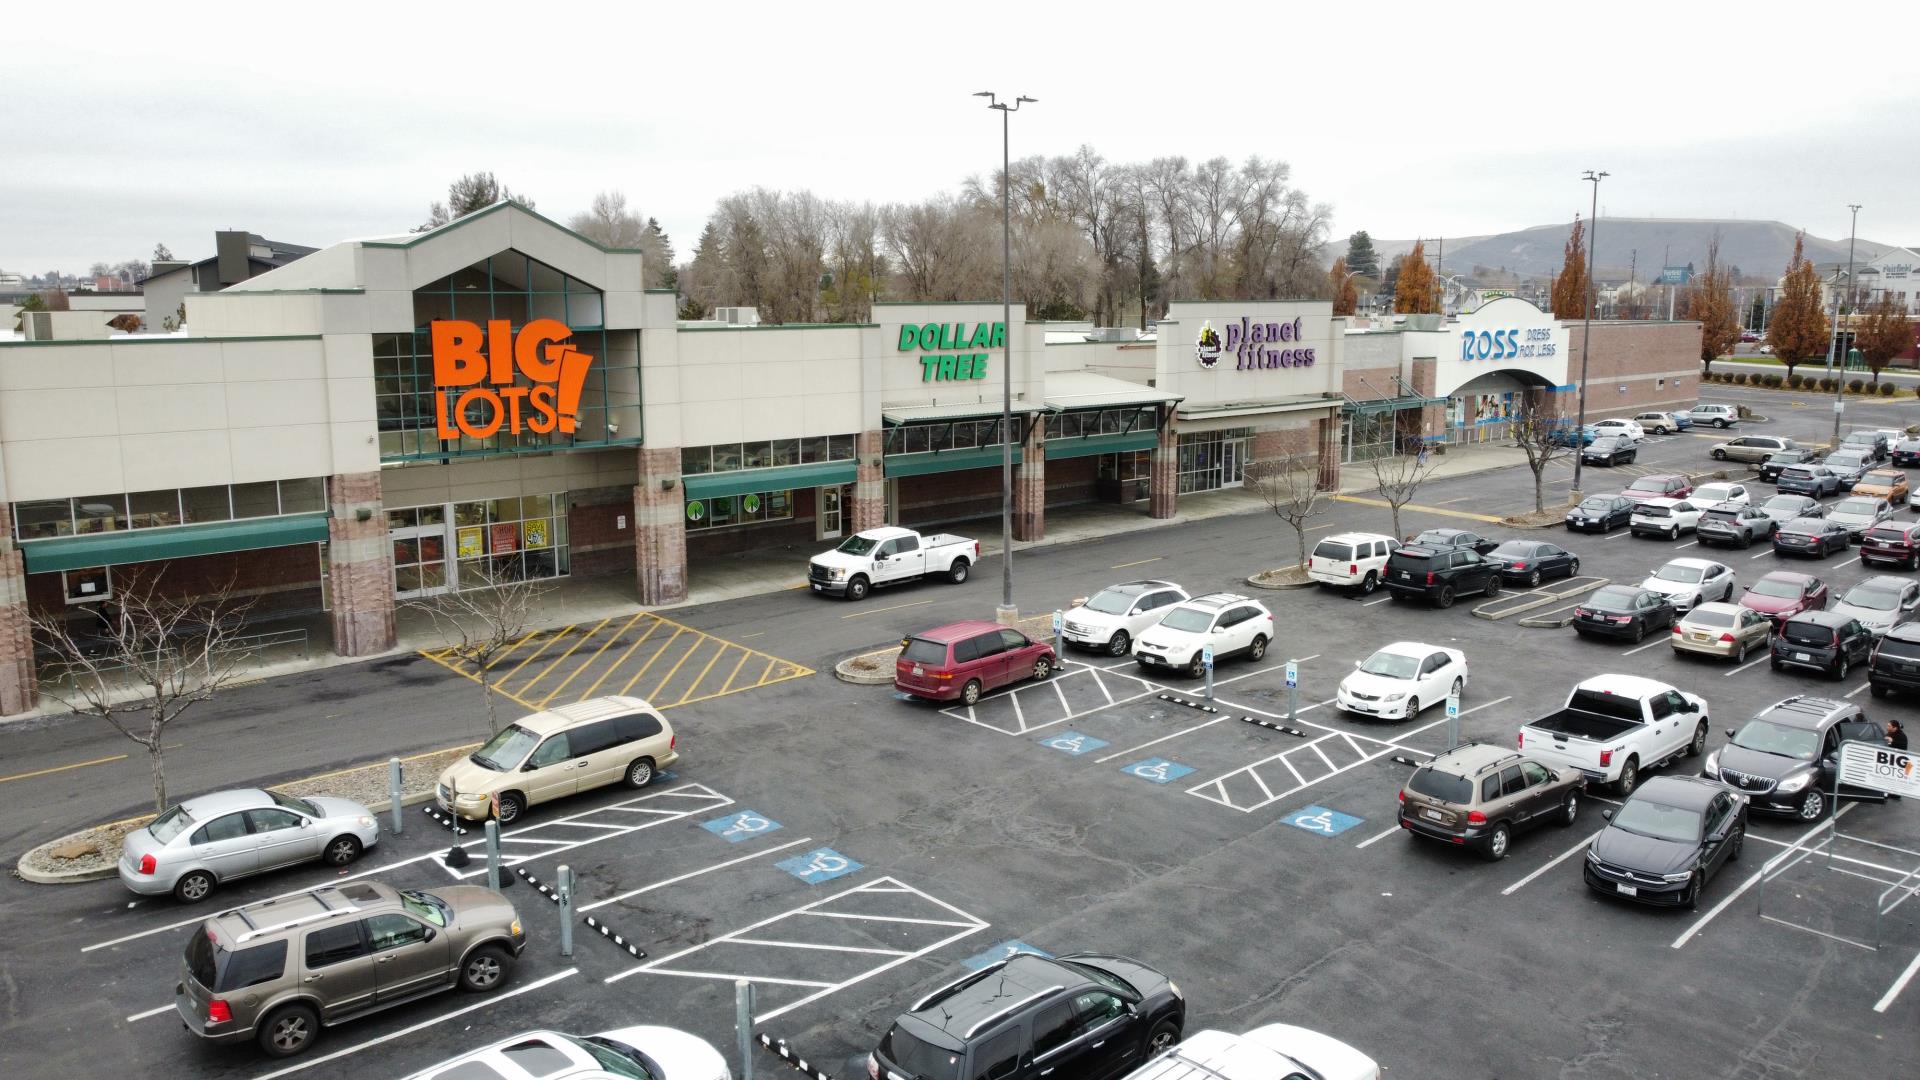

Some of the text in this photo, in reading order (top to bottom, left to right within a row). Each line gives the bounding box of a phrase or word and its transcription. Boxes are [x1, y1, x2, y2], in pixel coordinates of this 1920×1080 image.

[898, 322, 1006, 352] DOLLAR
[1225, 316, 1302, 351] planet
[1462, 329, 1519, 360] ROSS
[1527, 328, 1552, 341] DRESS
[431, 319, 577, 387] BIG
[1237, 343, 1316, 370] fitness
[1520, 344, 1556, 357] FOR LESS
[919, 353, 989, 382] TREE
[1876, 751, 1911, 768] BIG
